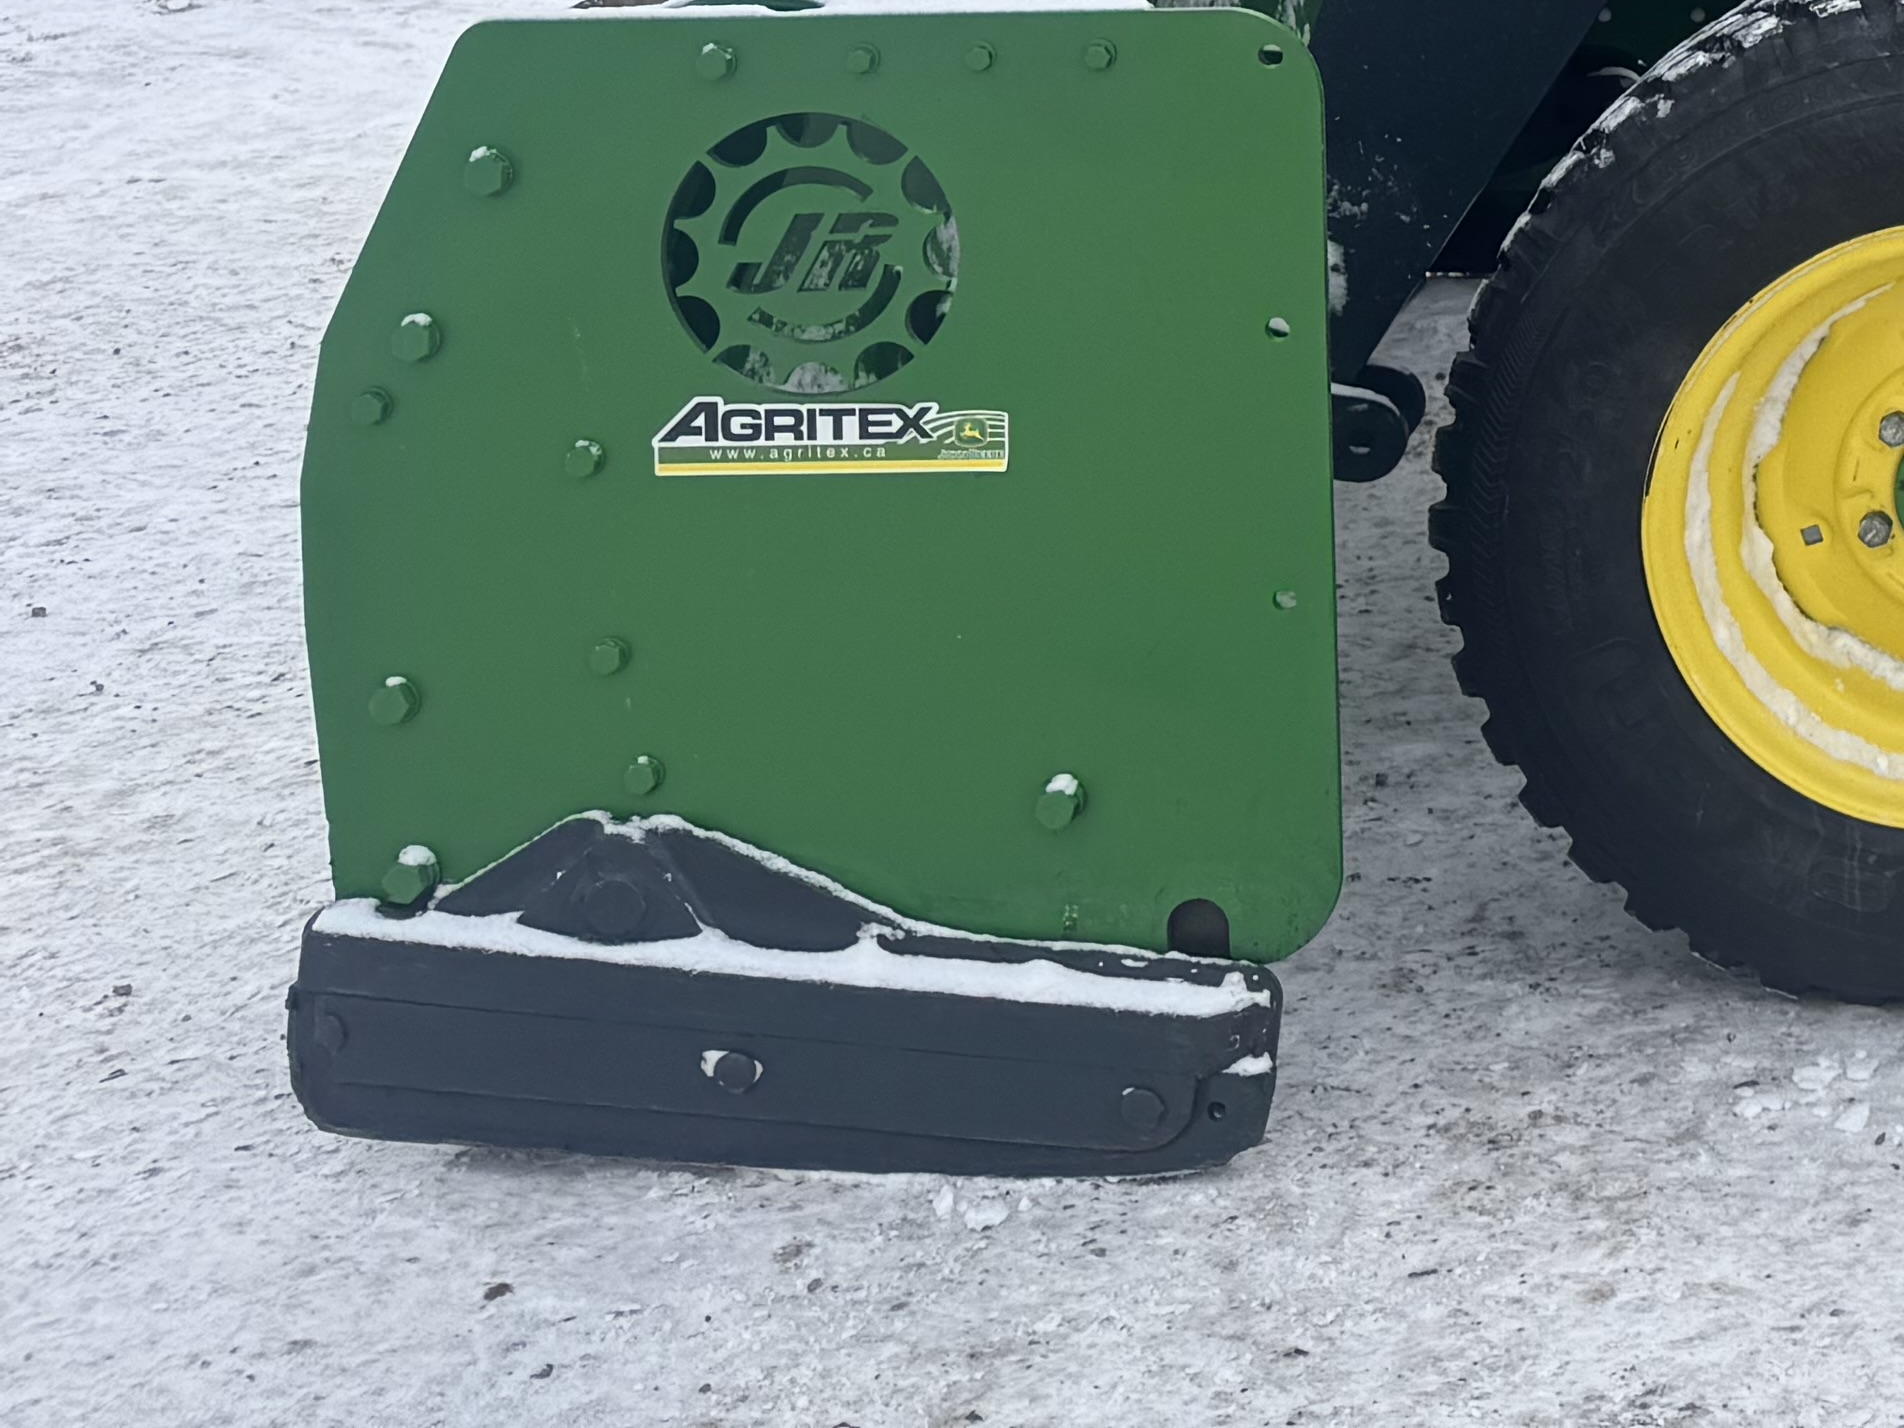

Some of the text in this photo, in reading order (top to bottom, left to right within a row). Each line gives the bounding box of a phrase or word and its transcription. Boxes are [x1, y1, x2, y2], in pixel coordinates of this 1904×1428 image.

[727, 211, 900, 293] JR
[657, 400, 935, 443] AGRITEX
[709, 445, 887, 463] www.agritex.ca
